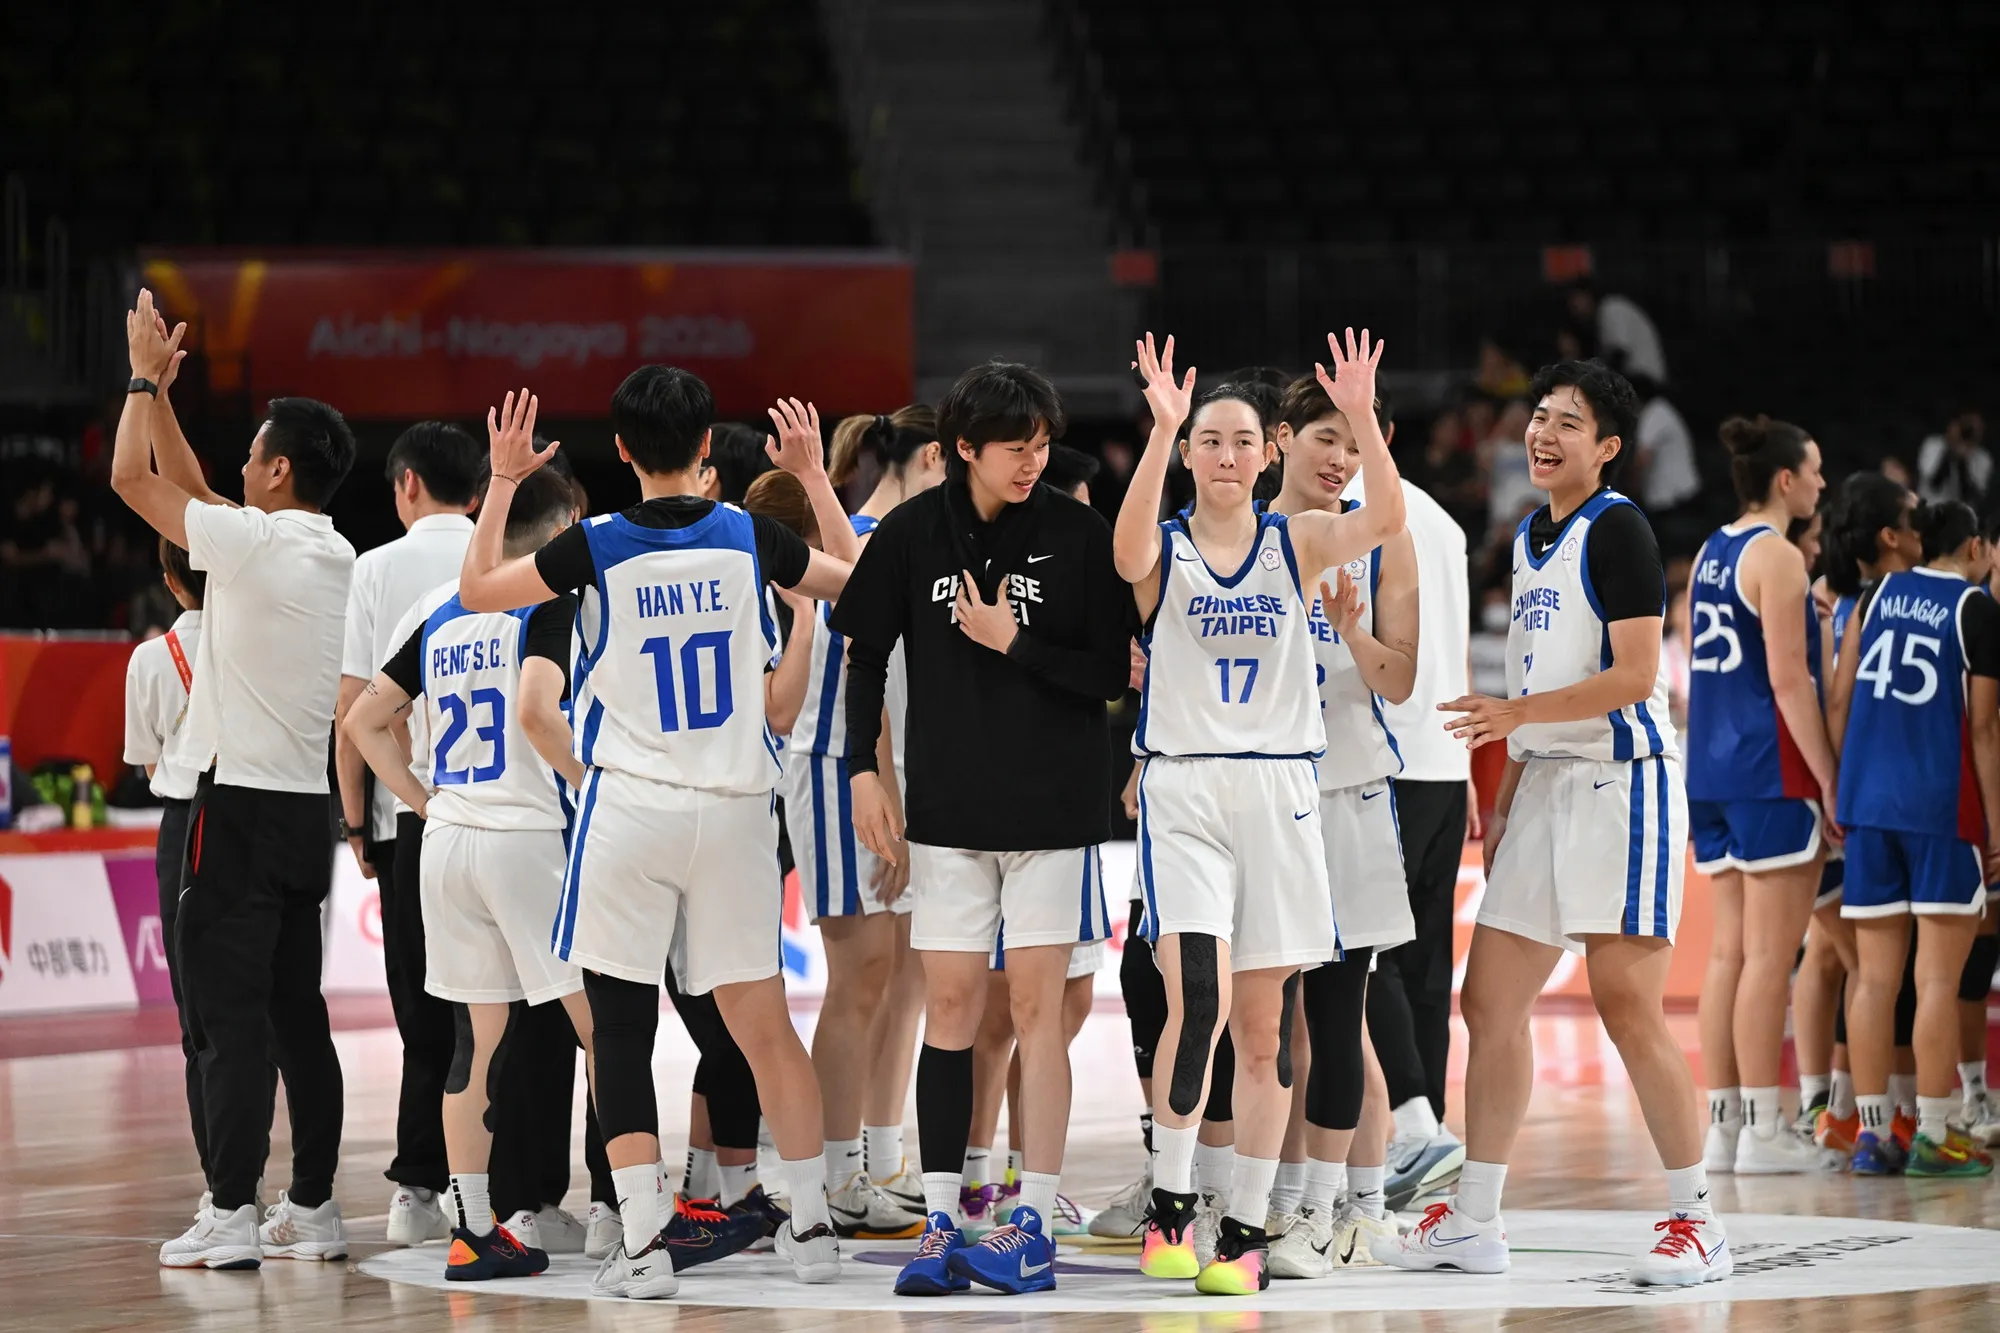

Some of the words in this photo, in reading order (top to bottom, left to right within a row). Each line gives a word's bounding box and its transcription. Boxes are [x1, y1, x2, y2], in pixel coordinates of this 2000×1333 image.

[309, 310, 627, 368] Aichi-Nagoya
[638, 315, 753, 357] 2026
[635, 584, 684, 618] HAN
[689, 579, 730, 613] Y.E.
[1187, 594, 1287, 616] CHINESE
[1513, 587, 1561, 621] CHINESE
[1880, 594, 1949, 630] MALAGAR
[1200, 615, 1277, 638] TAIPEI
[1691, 601, 1742, 674] 25
[473, 638, 506, 671] S.C.
[1856, 629, 1941, 705] 45
[639, 630, 734, 733] 10
[1214, 657, 1260, 704] 17
[433, 687, 506, 786] 23
